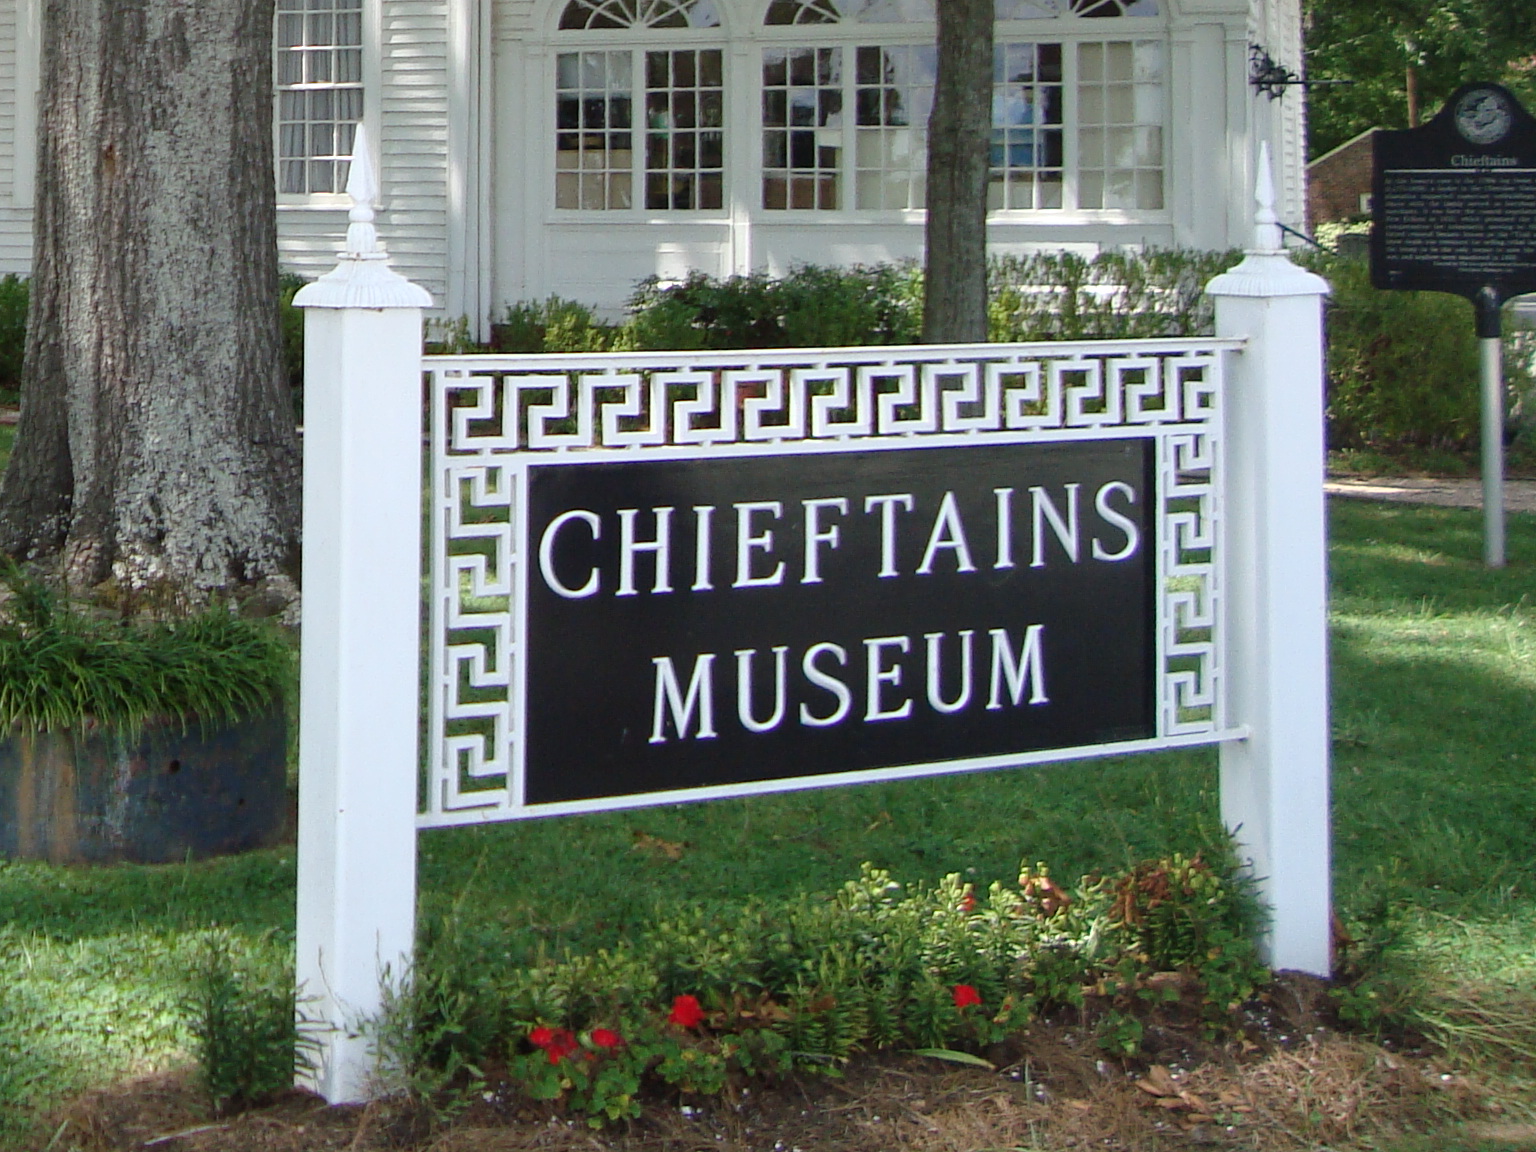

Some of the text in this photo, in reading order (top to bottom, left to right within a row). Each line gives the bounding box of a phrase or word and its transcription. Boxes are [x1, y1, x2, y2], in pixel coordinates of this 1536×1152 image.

[1450, 154, 1517, 167] Chieftains
[538, 480, 1141, 599] CHIEFTAINS
[648, 623, 1050, 745] MUSEUM
